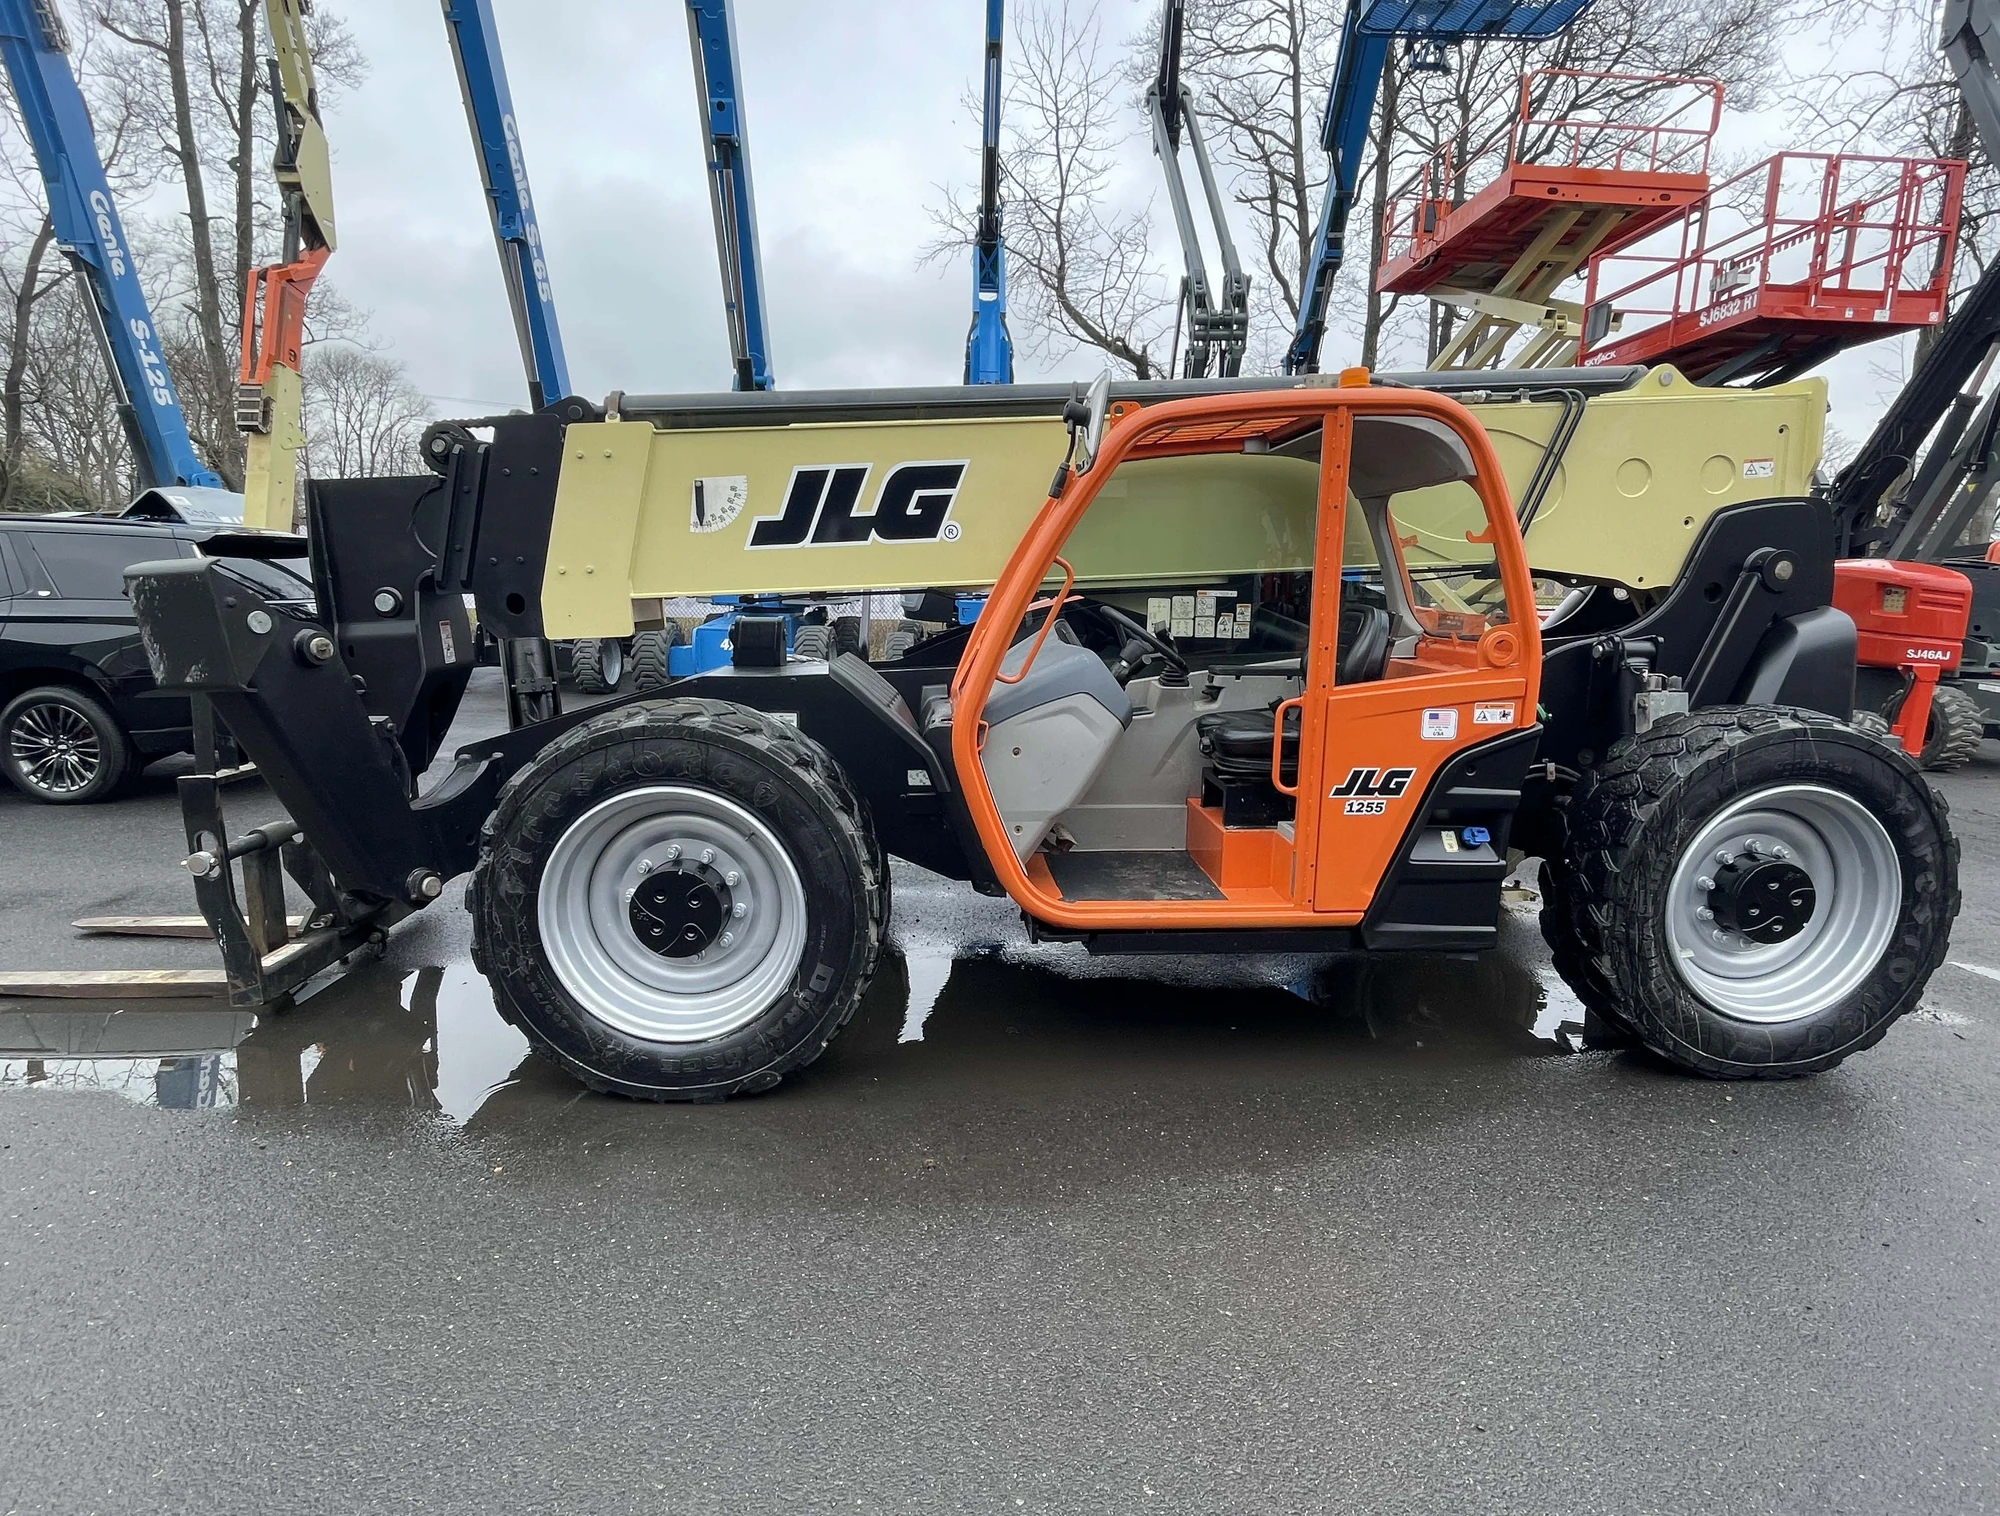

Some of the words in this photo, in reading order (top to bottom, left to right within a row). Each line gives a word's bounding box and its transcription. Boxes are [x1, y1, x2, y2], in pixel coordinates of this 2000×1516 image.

[503, 114, 531, 215] Genie
[525, 222, 551, 303] S-65
[90, 190, 126, 280] Genie
[130, 318, 174, 406] S-125
[1699, 298, 1740, 327] SJ6832
[746, 460, 969, 549] JLG
[1906, 649, 1951, 661] SJ46AJ
[1329, 768, 1416, 797] JLG
[1345, 801, 1385, 814] 1255
